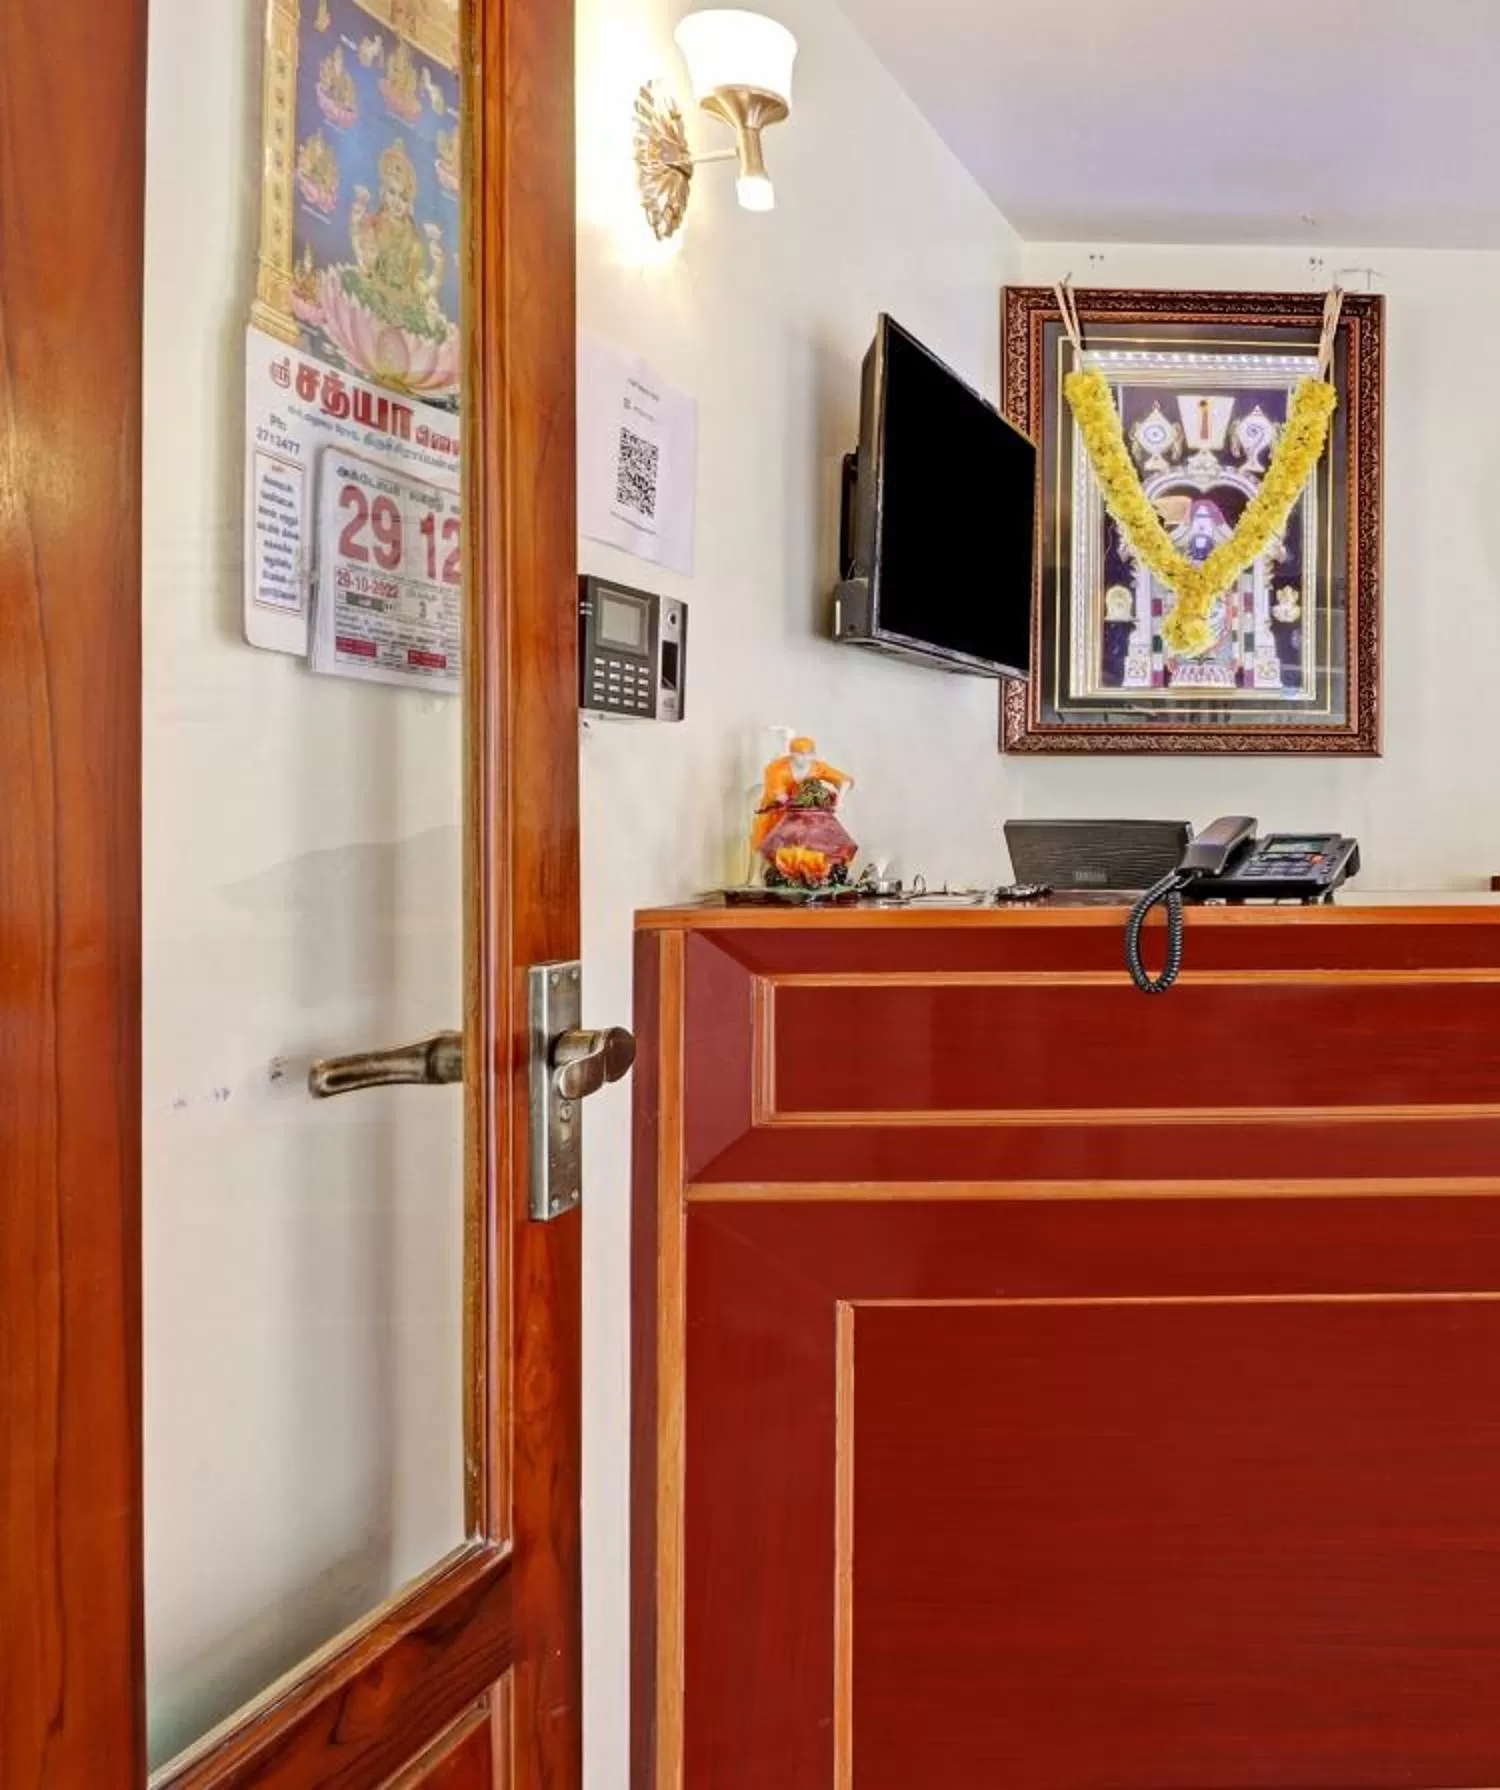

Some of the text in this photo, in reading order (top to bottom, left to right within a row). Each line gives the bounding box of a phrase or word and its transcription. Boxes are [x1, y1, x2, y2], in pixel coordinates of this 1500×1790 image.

[296, 362, 414, 441] சத்யா
[339, 483, 402, 571] 29
[420, 511, 461, 586] 12
